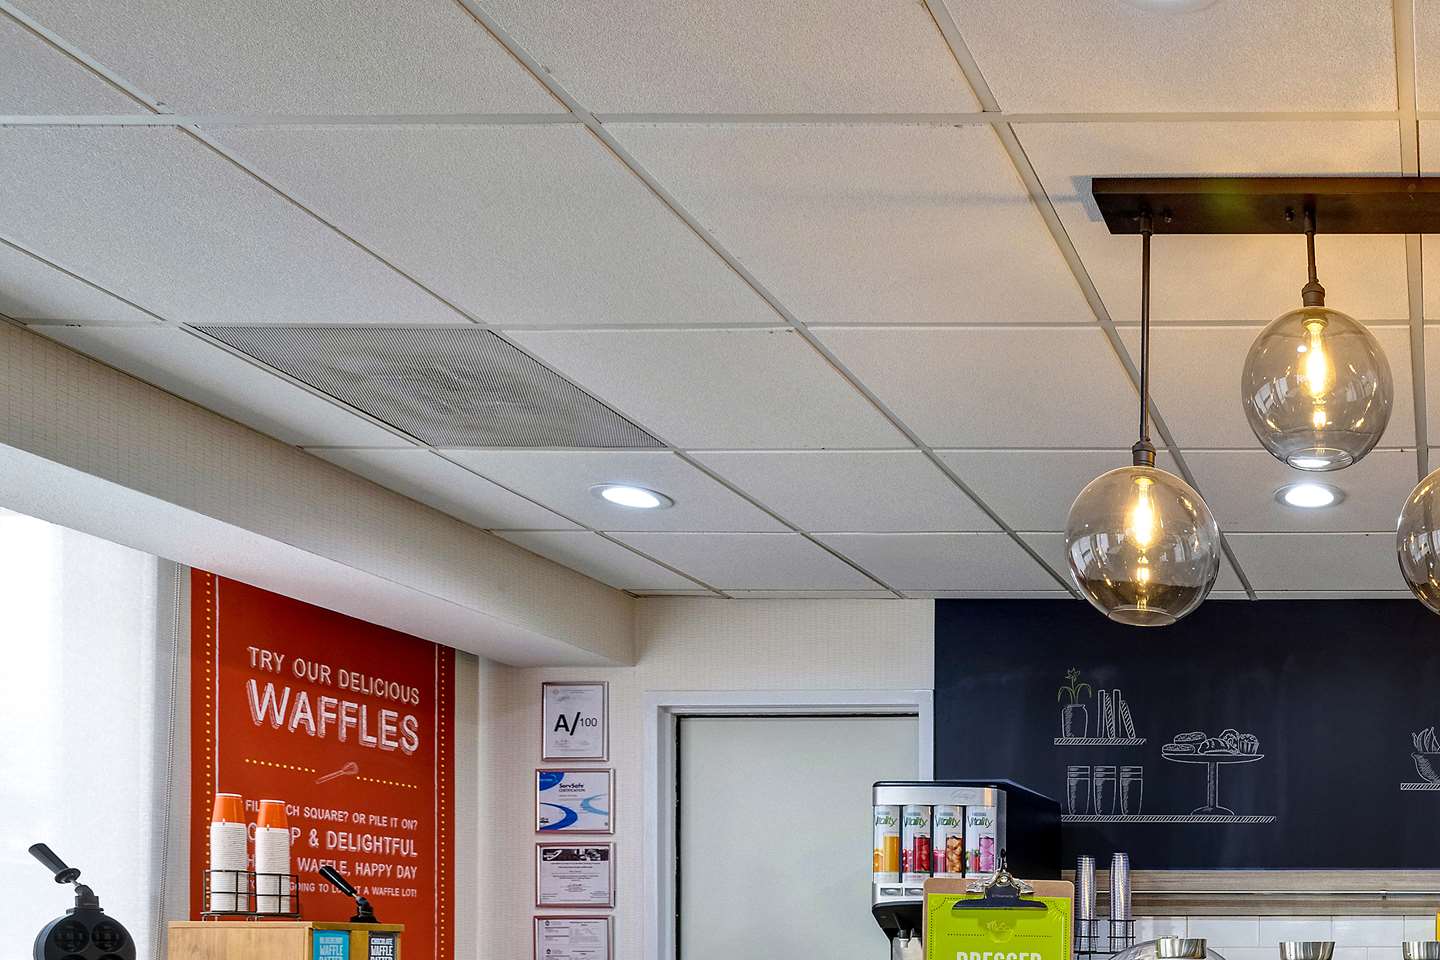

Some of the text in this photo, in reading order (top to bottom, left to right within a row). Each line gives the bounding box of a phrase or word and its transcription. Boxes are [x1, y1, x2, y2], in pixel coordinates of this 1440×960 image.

[247, 646, 420, 706] TRY OUR DELICIOUS
[246, 679, 420, 755] WAFFLES
[303, 806, 349, 823] SQUARE?
[352, 812, 366, 825] OR
[369, 815, 388, 828] PILE
[391, 817, 398, 829] IT
[401, 818, 418, 831] ON?
[325, 830, 418, 857] DELIGHTFUL
[355, 862, 393, 878] HAPPY
[397, 865, 418, 880] DAY
[319, 883, 330, 893] TO
[371, 885, 400, 897] WAFFLE
[401, 887, 417, 898] LOT!
[319, 944, 343, 956] WAFFLE
[370, 945, 393, 957] WAFFLE
